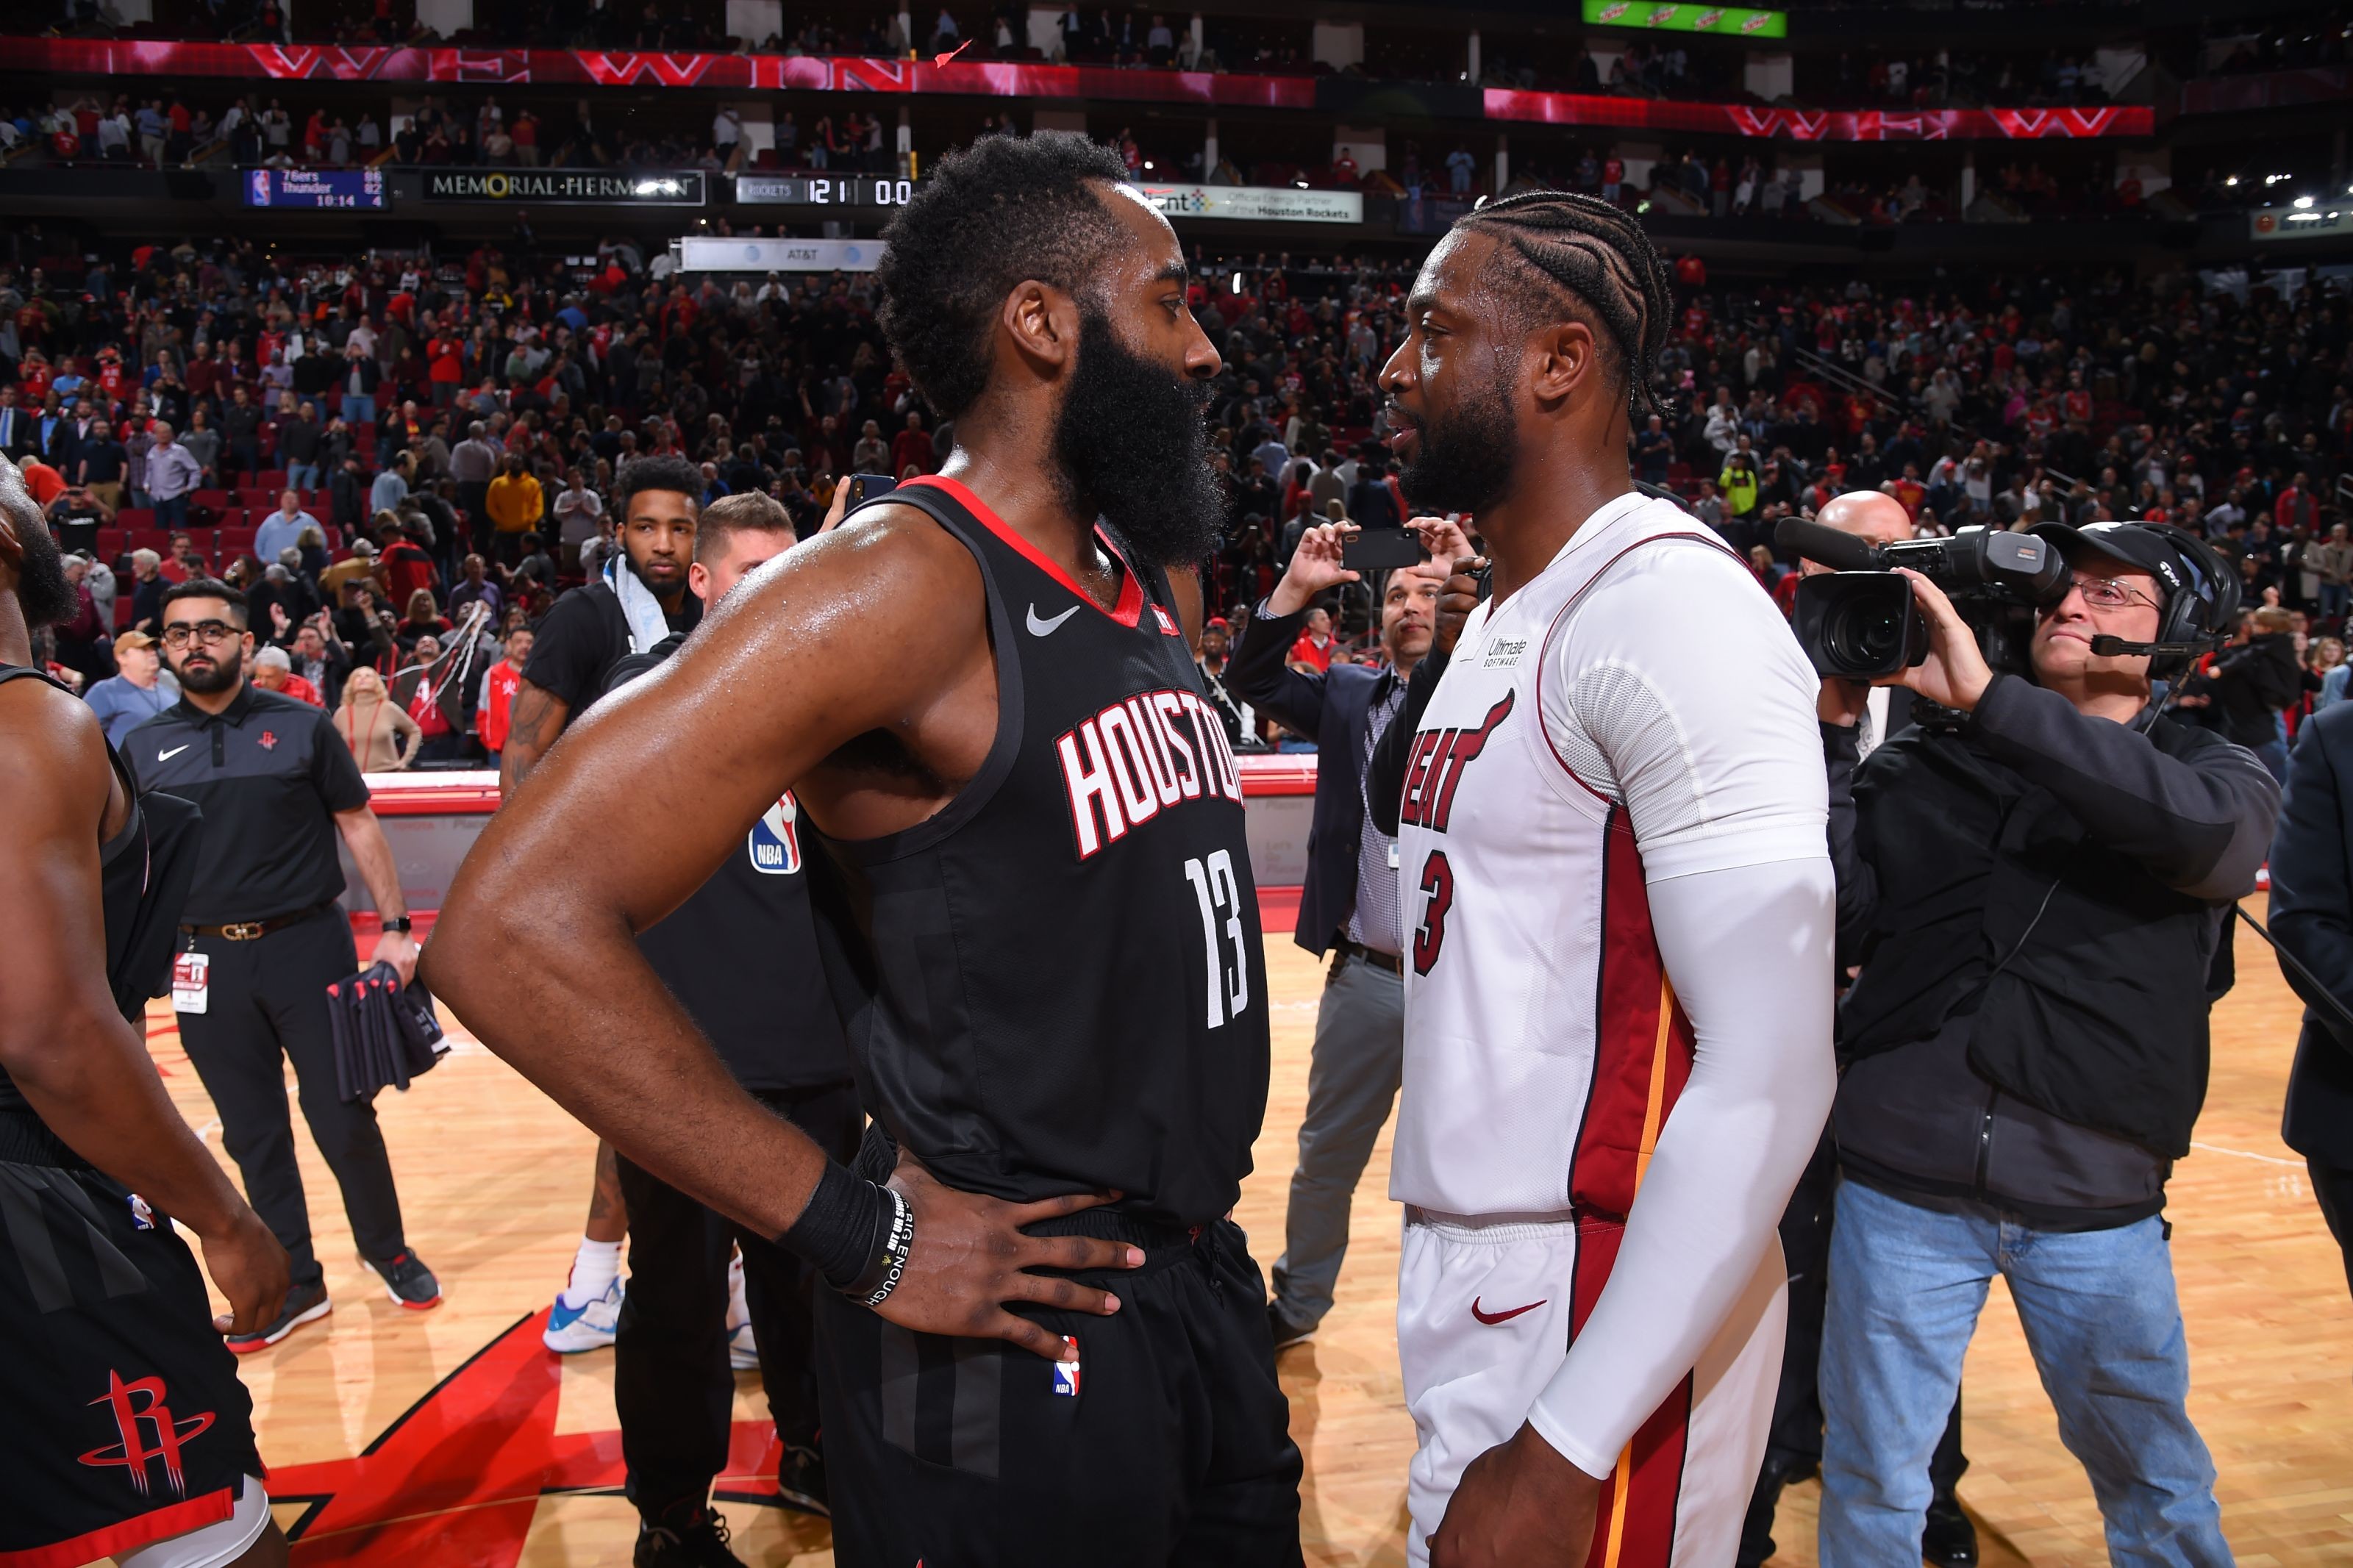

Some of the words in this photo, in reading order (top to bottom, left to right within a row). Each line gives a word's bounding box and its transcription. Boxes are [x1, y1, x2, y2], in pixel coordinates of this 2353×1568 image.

[282, 170, 319, 182] 76ers
[282, 182, 333, 194] Thunder
[432, 174, 558, 196] MEMORIAL
[748, 183, 792, 197] ROCKETS
[875, 179, 912, 205] 0.0
[316, 194, 355, 207] 10:14
[372, 195, 382, 207] 4
[1227, 191, 1261, 203] Official
[1263, 193, 1295, 205] Energy
[1296, 194, 1332, 206] Partner
[1257, 205, 1304, 218] Houston
[1307, 208, 1350, 220] Rockets
[787, 249, 818, 260] AT&T
[1488, 637, 1527, 656] Ultimate
[1483, 656, 1519, 668] SOFTWARE
[757, 844, 783, 865] NBA
[1413, 848, 1454, 978] 3
[1184, 848, 1249, 1029] 13
[893, 1217, 904, 1233] UR
[887, 1231, 901, 1251] HIT
[864, 1244, 909, 1307] ENOUGH
[1055, 1383, 1070, 1394] NBA
